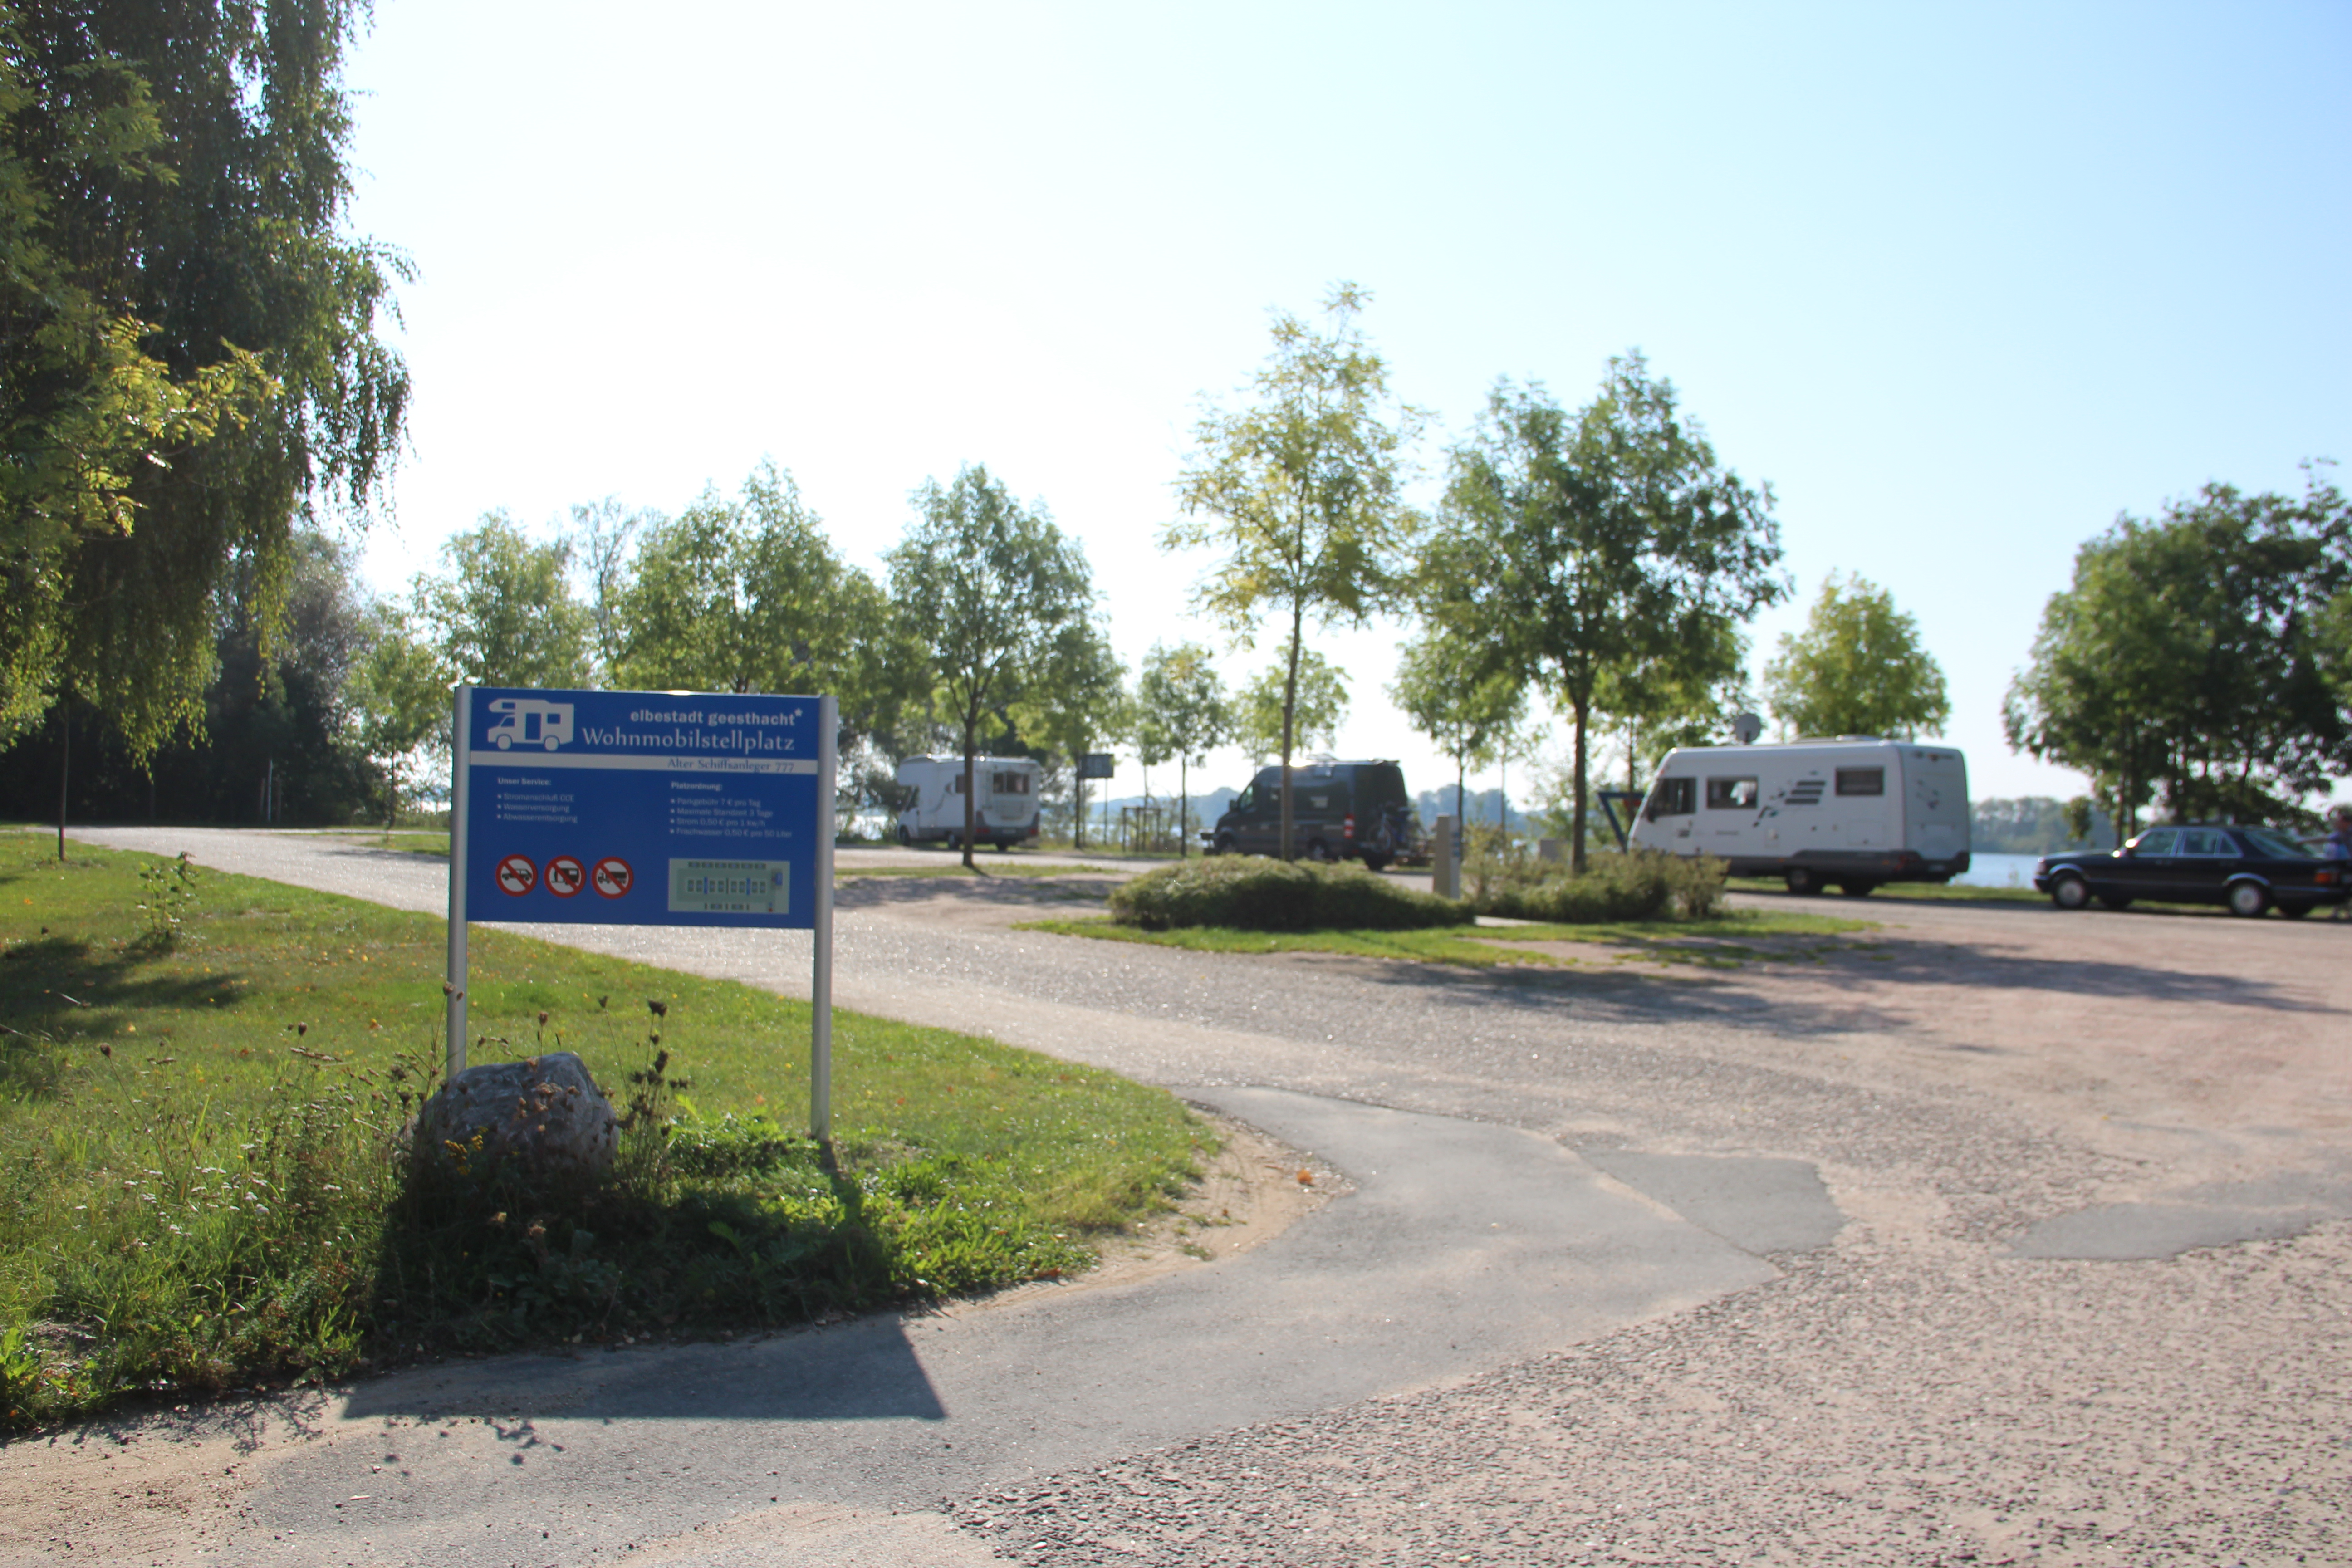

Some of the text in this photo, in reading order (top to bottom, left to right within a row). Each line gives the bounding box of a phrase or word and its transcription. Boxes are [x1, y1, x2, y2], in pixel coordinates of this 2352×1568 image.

[631, 709, 703, 724] elbestadt
[583, 727, 794, 755] Wohnmobilstellplatz
[668, 758, 794, 773] Alter Schiffsanleger 777
